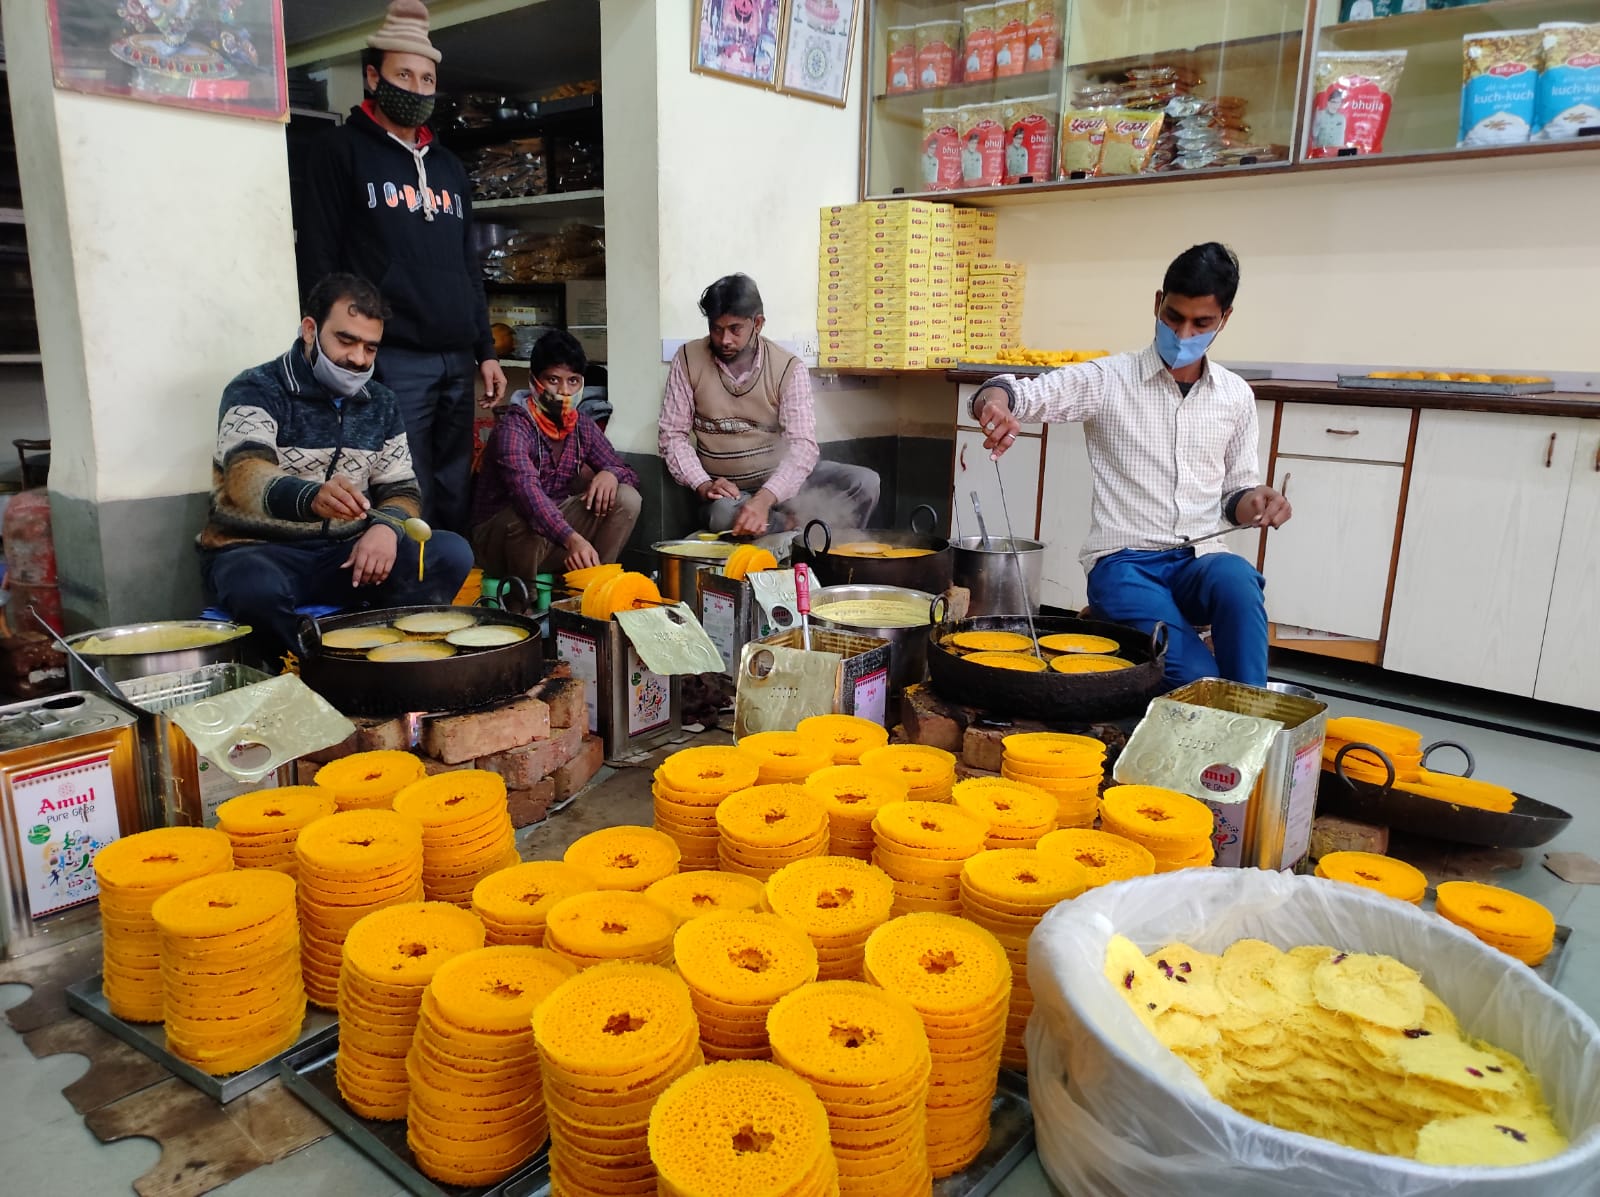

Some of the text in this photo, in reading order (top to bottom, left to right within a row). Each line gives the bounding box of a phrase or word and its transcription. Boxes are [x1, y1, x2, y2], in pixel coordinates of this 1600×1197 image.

[1552, 80, 1600, 97] kuch-ku
[1351, 99, 1384, 113] bhujia
[1203, 770, 1235, 786] mul
[37, 787, 96, 817] Amul
[47, 811, 70, 825] Pure
